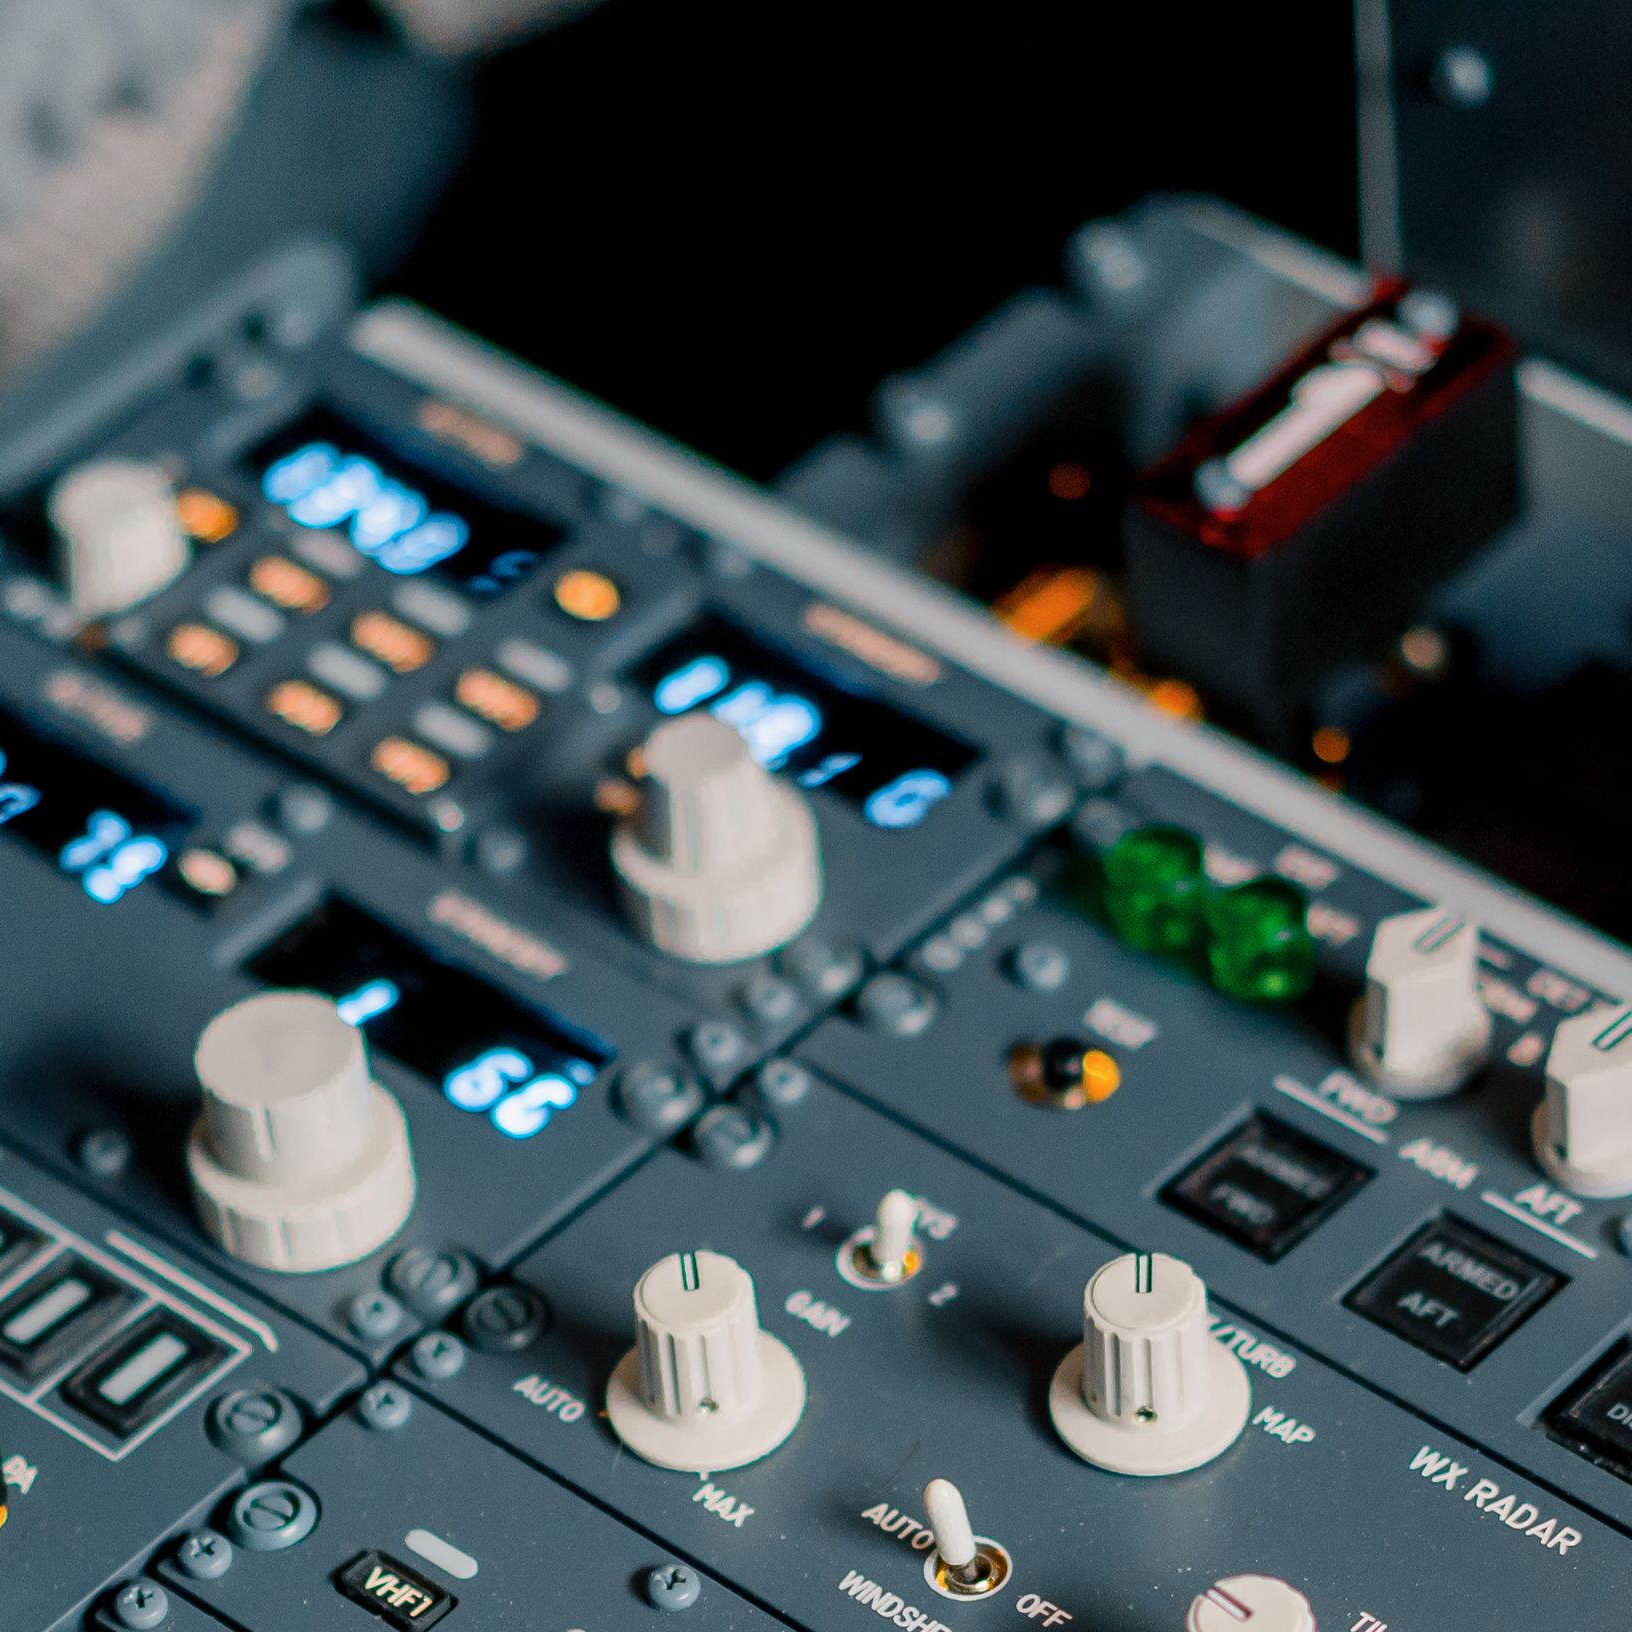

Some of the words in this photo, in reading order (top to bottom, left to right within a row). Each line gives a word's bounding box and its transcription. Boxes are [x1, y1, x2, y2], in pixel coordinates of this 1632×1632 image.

[1228, 358, 1385, 491] 1
[1318, 1071, 1399, 1125] FWD
[1514, 1184, 1583, 1225] AFT
[1420, 1243, 1519, 1302] ARMED
[784, 1289, 852, 1338] GAIN
[1397, 1293, 1459, 1328] AFT
[512, 1373, 587, 1422] AUTO
[1252, 1405, 1316, 1449] MAP
[2, 1454, 39, 1495] PA
[691, 1481, 755, 1528] MAX
[1409, 1443, 1467, 1496] WX
[1461, 1473, 1584, 1560] RADAR
[861, 1501, 936, 1552] AUTO
[363, 1564, 434, 1621] VHF1
[1016, 1593, 1072, 1632] OFF
